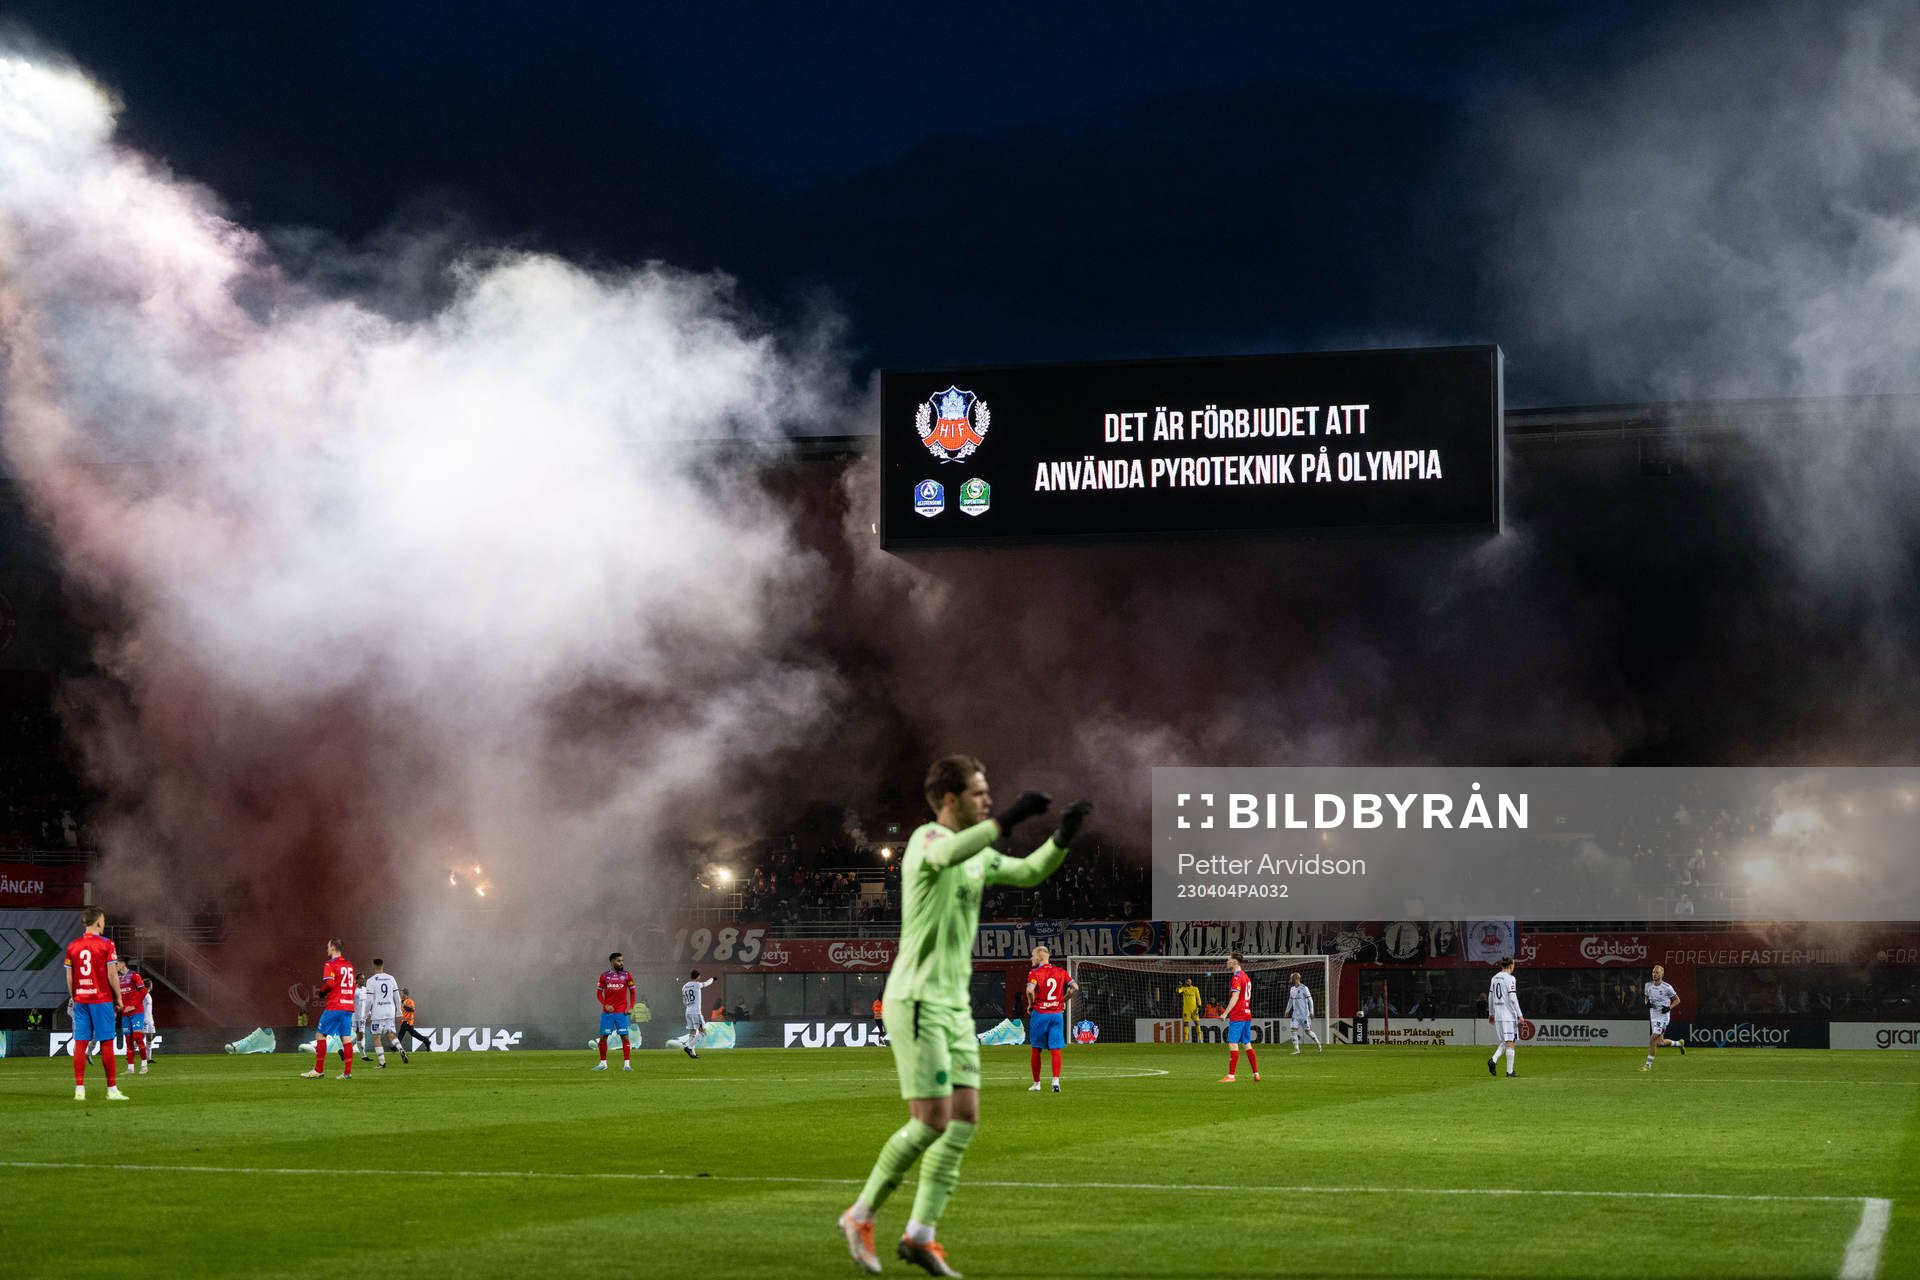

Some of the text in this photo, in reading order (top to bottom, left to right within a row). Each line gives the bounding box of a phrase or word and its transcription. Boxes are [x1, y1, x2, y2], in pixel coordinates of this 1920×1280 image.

[1104, 404, 1370, 443] DET ÄR FÖRBJUDET ATT
[1034, 445, 1443, 492] ANVÄNDA PYROTEKNIK PÅ OLYMPIA
[0, 874, 44, 895] ÄNGEN
[675, 928, 766, 963] 1985
[1171, 921, 1327, 956] KOMPANIET
[1580, 937, 1648, 963] Carlsberg
[79, 949, 92, 976] 3
[828, 942, 890, 966] Carlsberg
[1664, 950, 1739, 965] FOREVER
[1740, 950, 1801, 964] FASTER
[340, 966, 354, 988] 25
[380, 983, 388, 999] 9
[684, 989, 696, 1002] 18
[1046, 977, 1057, 1001] 2
[784, 1022, 893, 1048] FUTUR
[1154, 1020, 1280, 1043] tilmbil
[1367, 1028, 1454, 1039] nssons Plåtslageri
[1537, 1024, 1609, 1038] AllOffice
[1689, 1023, 1790, 1043] kondektor
